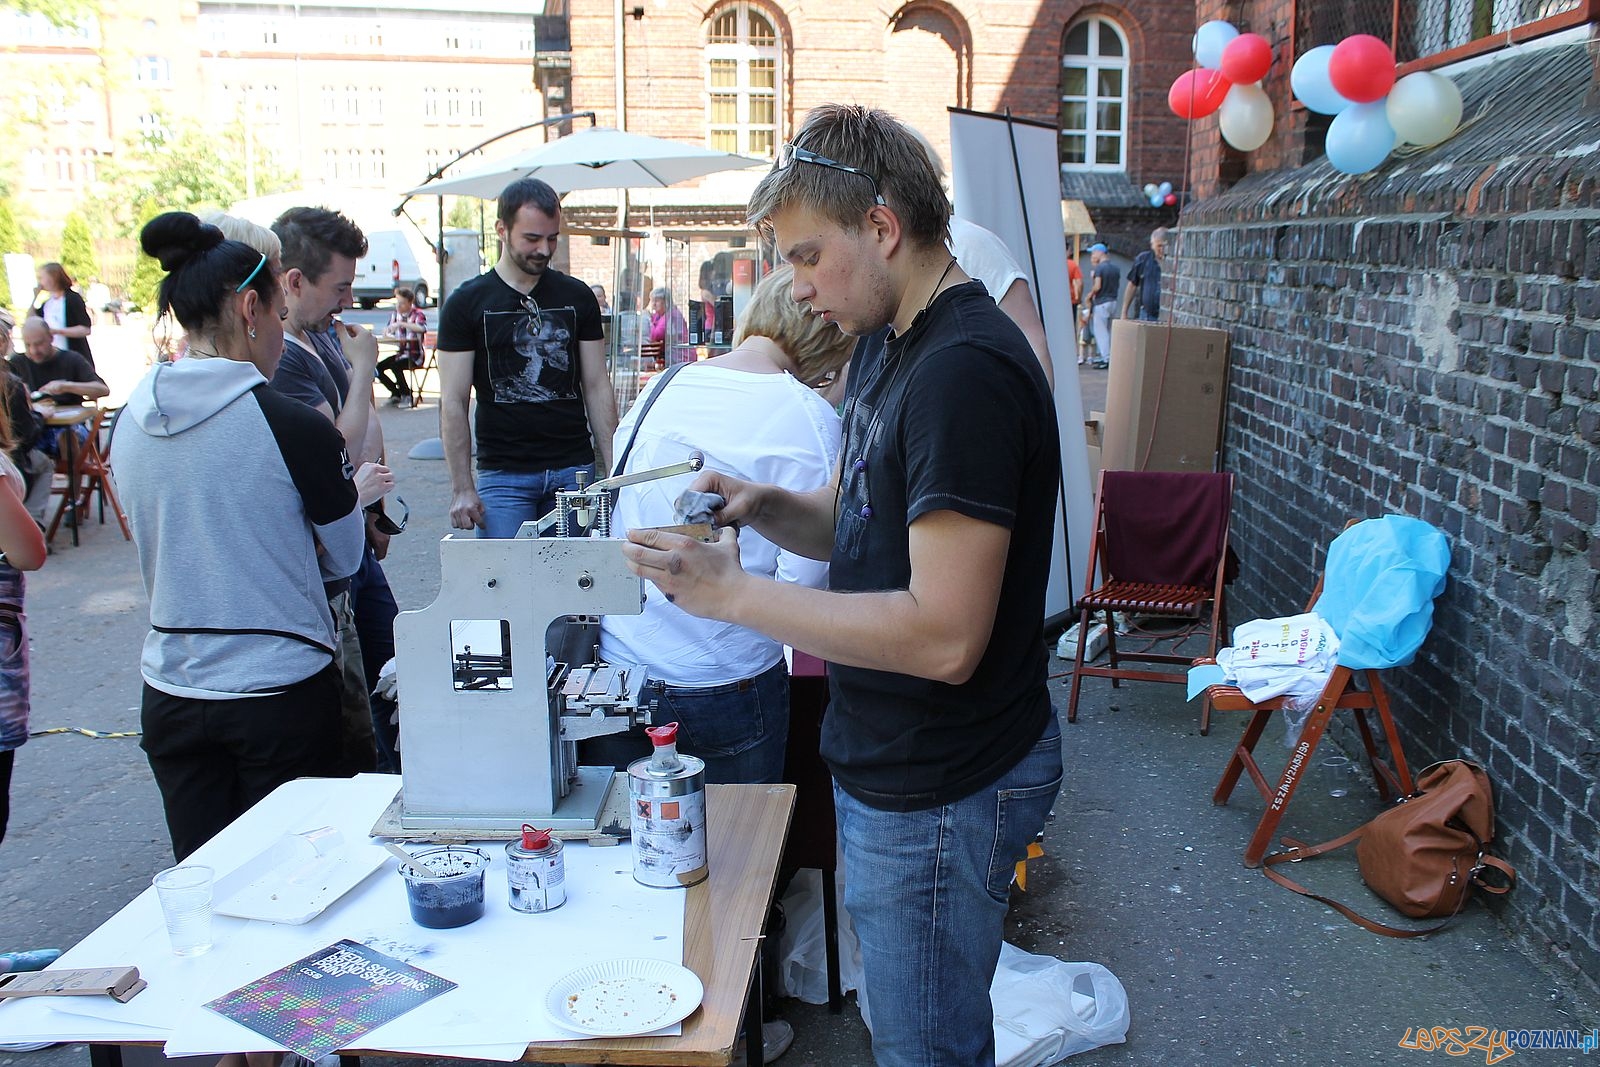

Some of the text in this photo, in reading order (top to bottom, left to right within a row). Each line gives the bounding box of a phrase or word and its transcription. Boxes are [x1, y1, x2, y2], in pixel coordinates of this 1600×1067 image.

[311, 960, 348, 978] PRINT
[323, 955, 394, 986] BRAND SHOP
[335, 949, 429, 991] MEDIA SOLUTIONS
